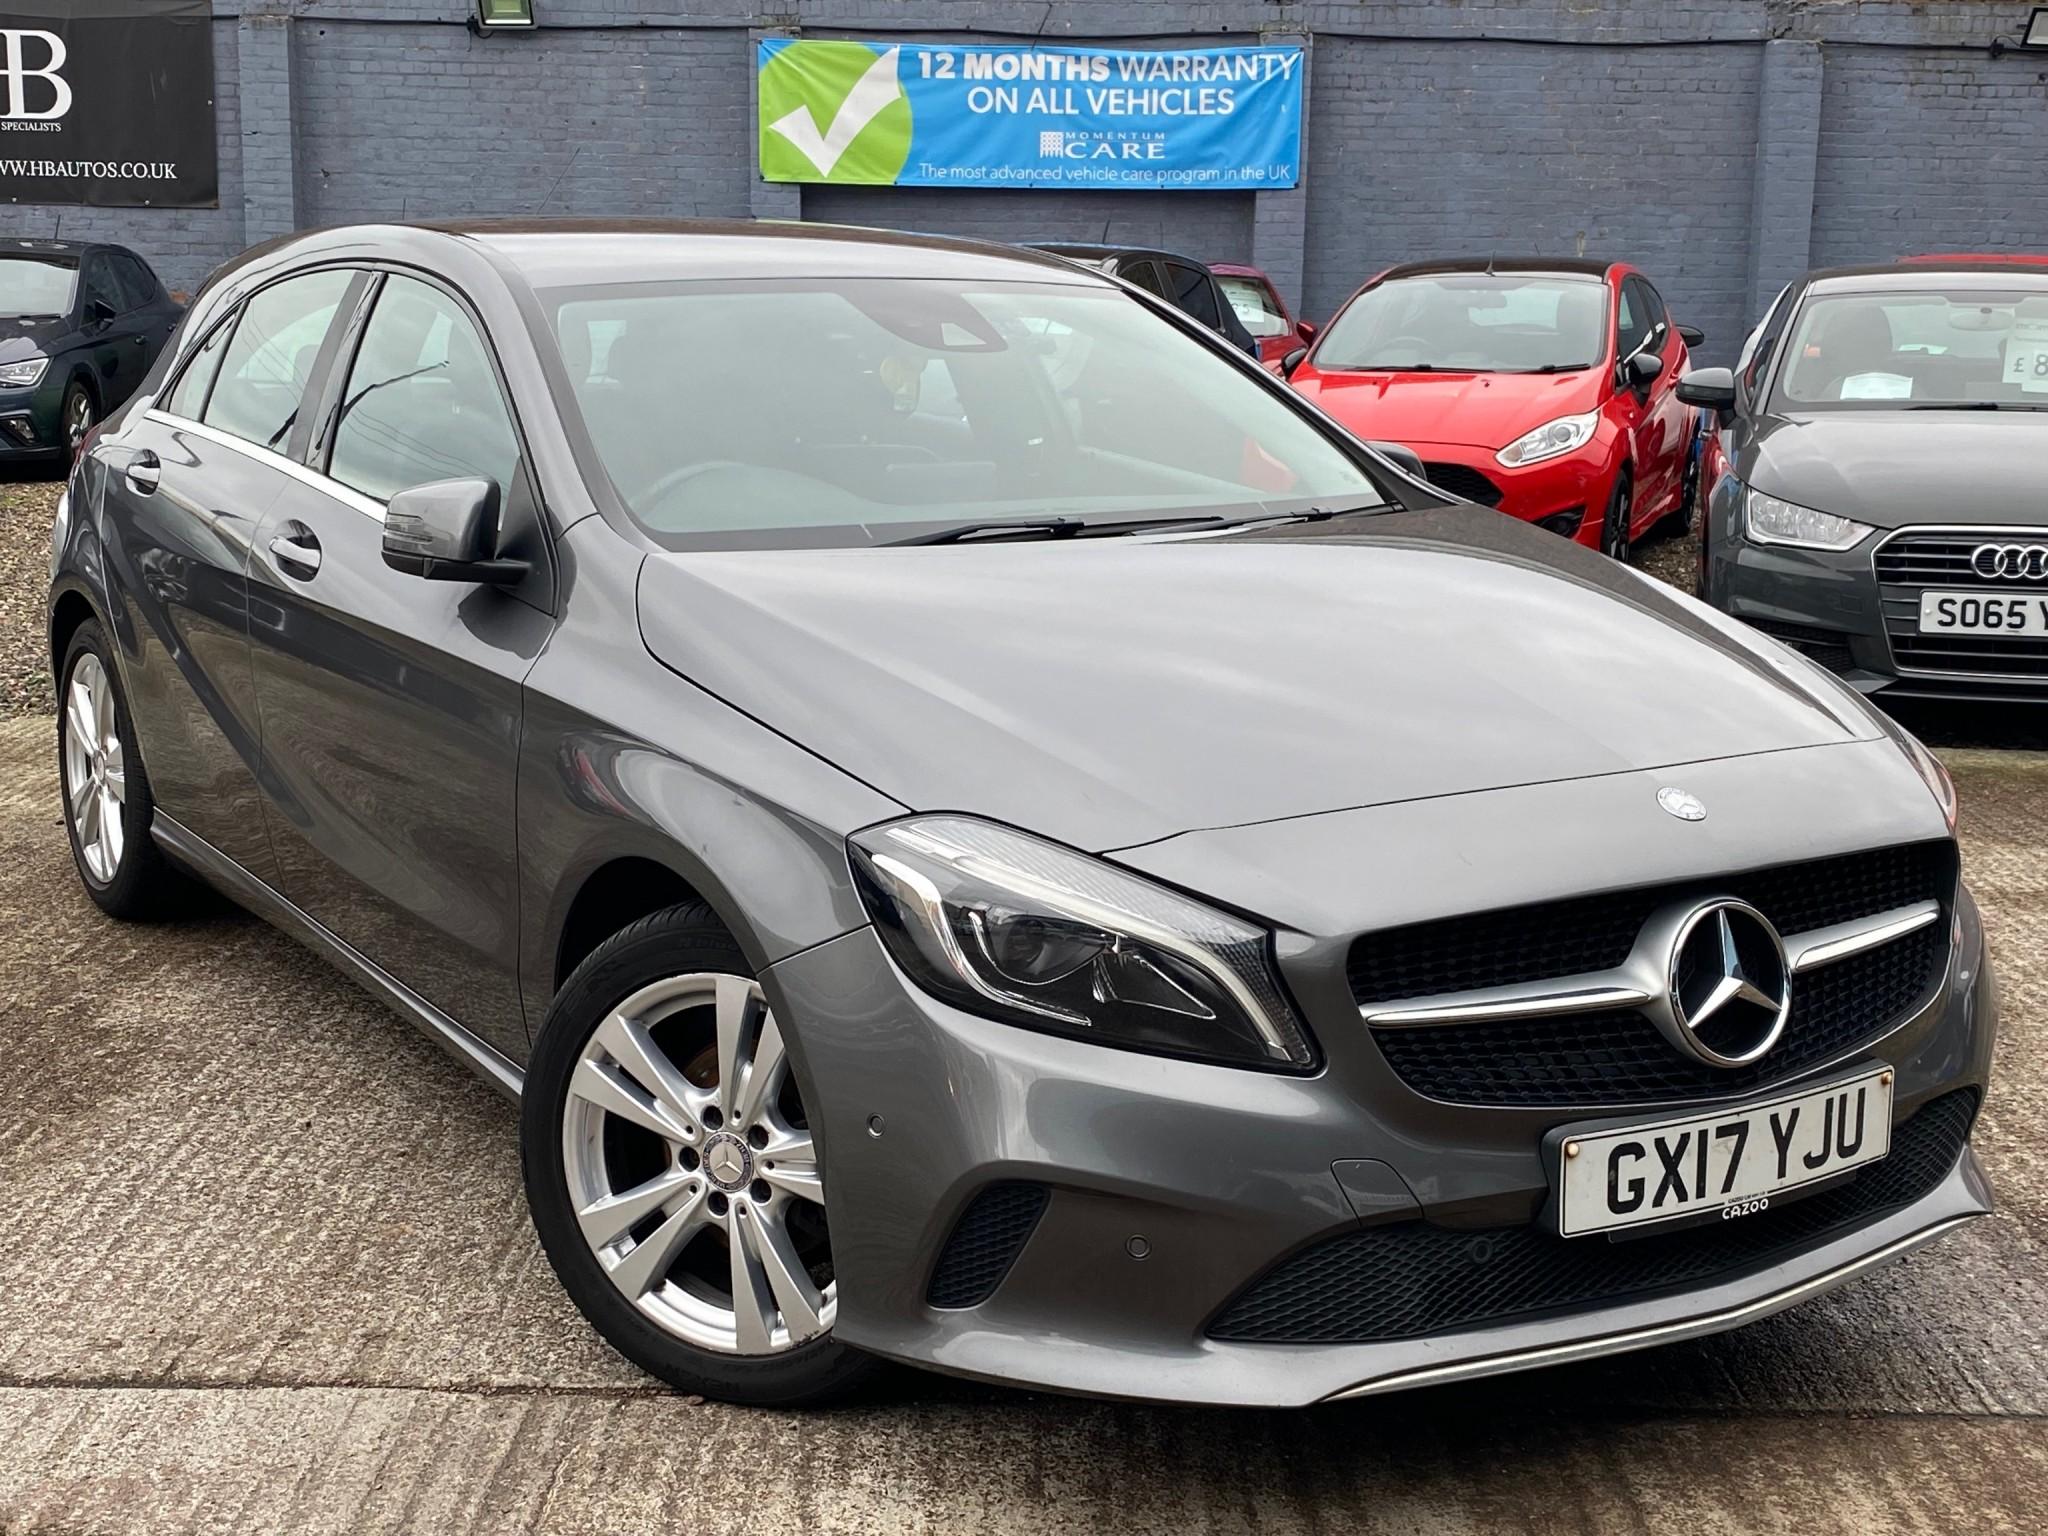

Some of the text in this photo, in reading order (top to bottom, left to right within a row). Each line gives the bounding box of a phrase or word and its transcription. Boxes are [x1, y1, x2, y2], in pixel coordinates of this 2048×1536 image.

[918, 52, 1298, 82] 12 MONTHS WARRANTY
[967, 86, 1235, 116] ON ALL VEHICLES
[1, 121, 62, 132] SPECIALISTS
[1064, 131, 1166, 141] MOMENTUM
[1064, 142, 1166, 160] CARE
[919, 163, 1290, 185] The most advanced vehicle care program in the UK
[1607, 1087, 1866, 1215] GX17 YJU
[1722, 1198, 1769, 1220] CAZOO
